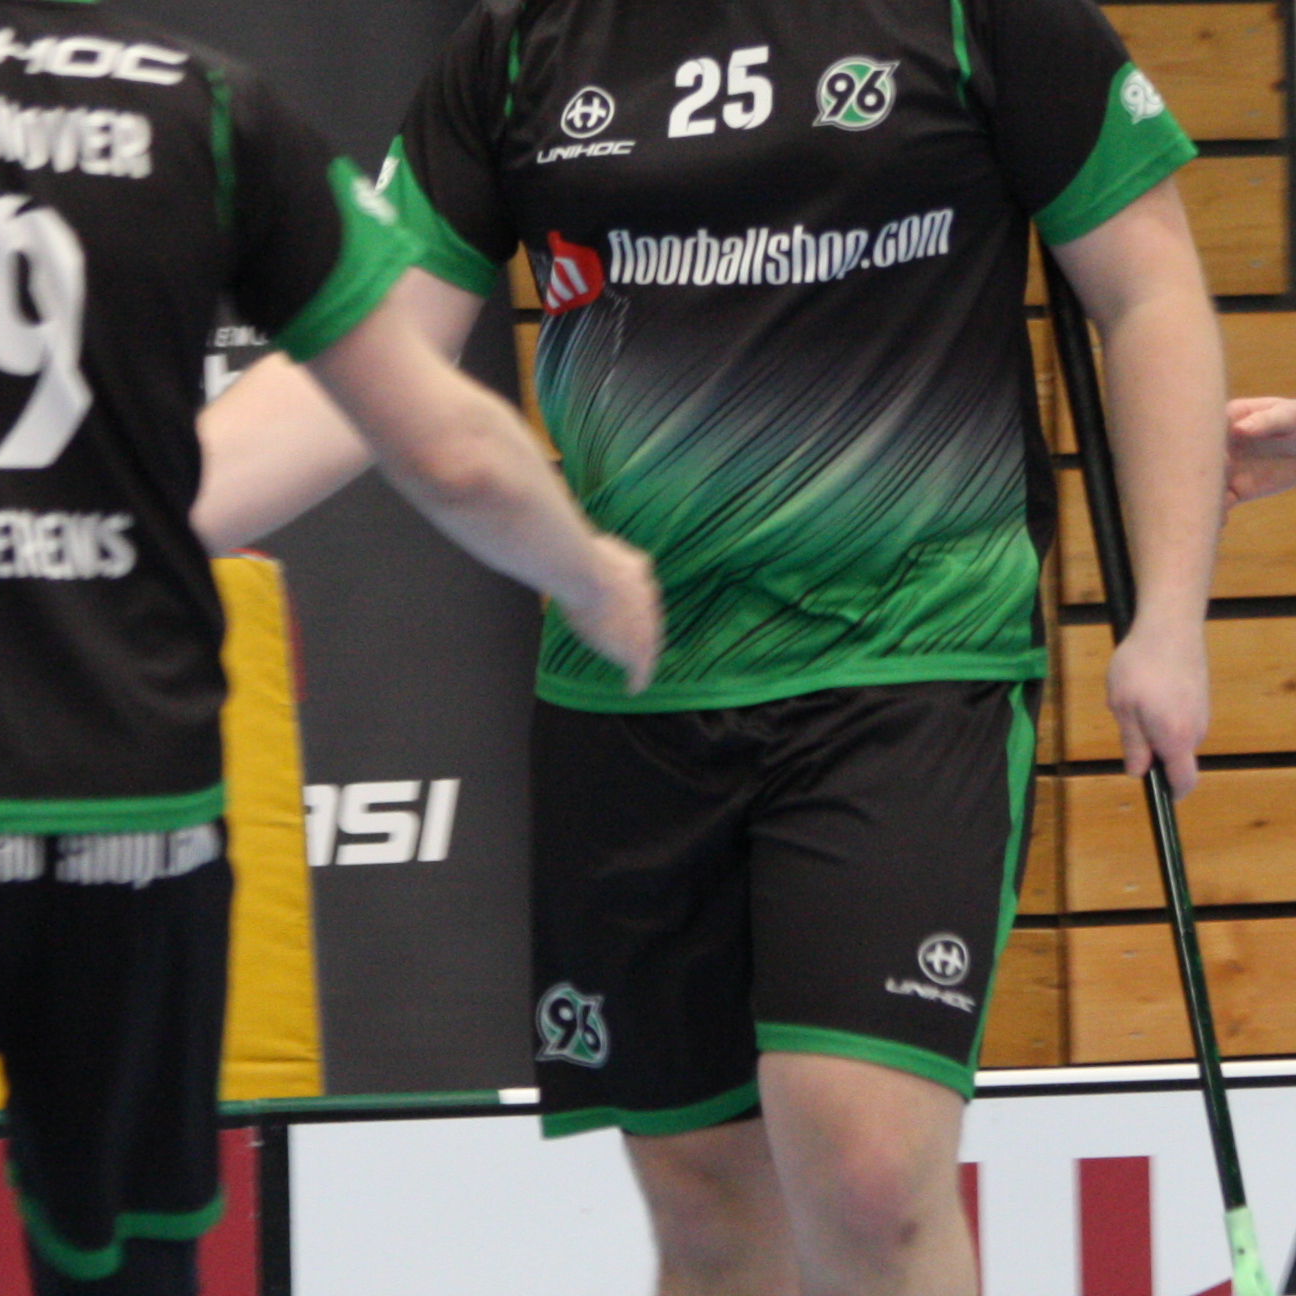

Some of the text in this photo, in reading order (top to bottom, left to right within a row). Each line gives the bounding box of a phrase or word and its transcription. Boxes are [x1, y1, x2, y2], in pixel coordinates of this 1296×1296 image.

[668, 44, 773, 138] 25
[536, 140, 637, 164] UNIHOC
[608, 207, 954, 286] floorballshop.com
